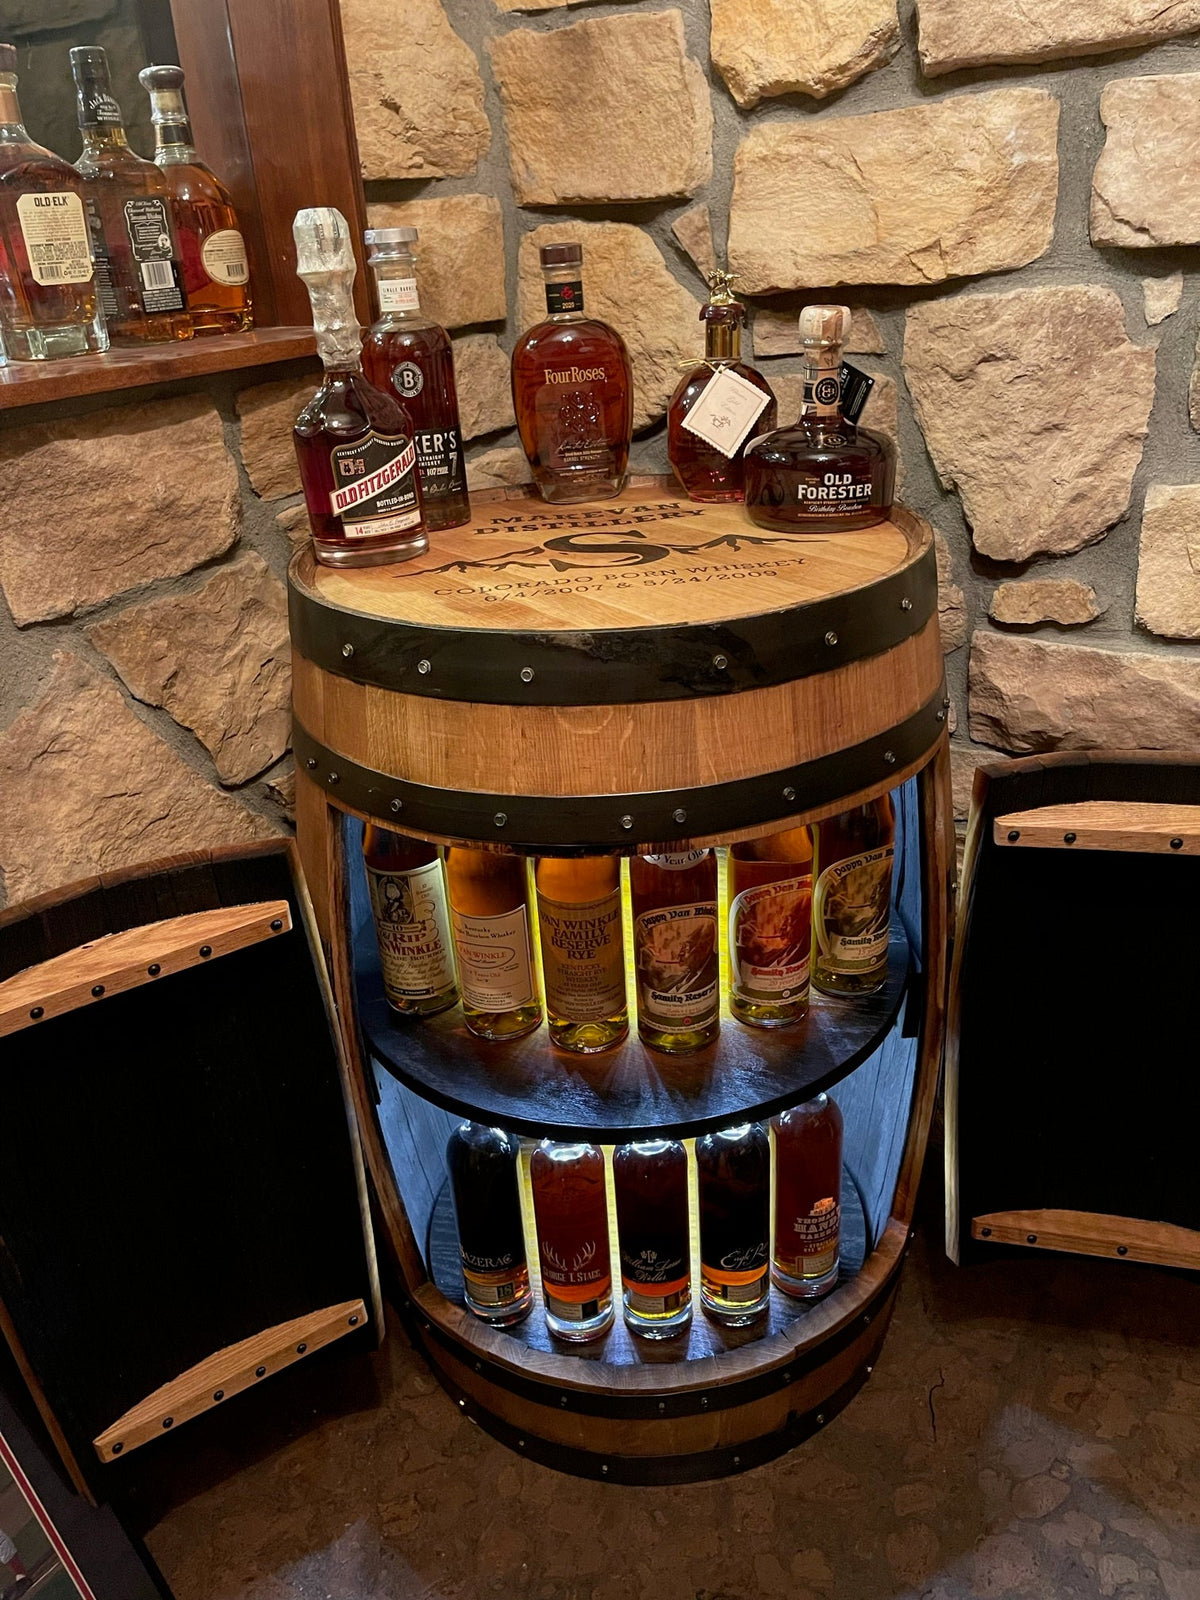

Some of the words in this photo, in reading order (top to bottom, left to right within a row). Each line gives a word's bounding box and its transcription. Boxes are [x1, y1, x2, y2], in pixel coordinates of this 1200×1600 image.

[33, 196, 51, 208] OLD
[52, 196, 69, 207] ELK
[402, 370, 415, 389] B
[544, 369, 571, 385] Four
[571, 366, 605, 383] Roses
[415, 430, 457, 454] KER'S
[337, 450, 358, 458] KENTUCKY
[418, 454, 445, 462] STRAIGHT
[449, 451, 458, 476] 7
[335, 488, 358, 510] OLD
[356, 444, 415, 500] FITZGERALD
[824, 473, 852, 486] OLD
[797, 483, 873, 500] FORESTER
[490, 502, 681, 525] MAKEVAN
[808, 504, 837, 513] Birthday
[474, 509, 705, 535] DISTILLERY
[355, 526, 364, 535] 14
[542, 530, 671, 573] S
[434, 575, 593, 595] COLORADO
[604, 569, 677, 581] BORN
[686, 558, 806, 574] WHISKEY
[664, 855, 686, 865] Year
[864, 852, 883, 864] Van
[540, 910, 560, 928] VAN
[563, 907, 619, 930] WINKLE
[668, 908, 691, 919] Van
[392, 924, 404, 932] 10
[554, 926, 606, 941] FAMILY
[388, 939, 442, 956] WINKLE
[551, 934, 611, 951] RESERVE
[472, 951, 506, 960] WINKLE
[567, 949, 596, 960] RYE
[498, 1284, 513, 1297] 18
